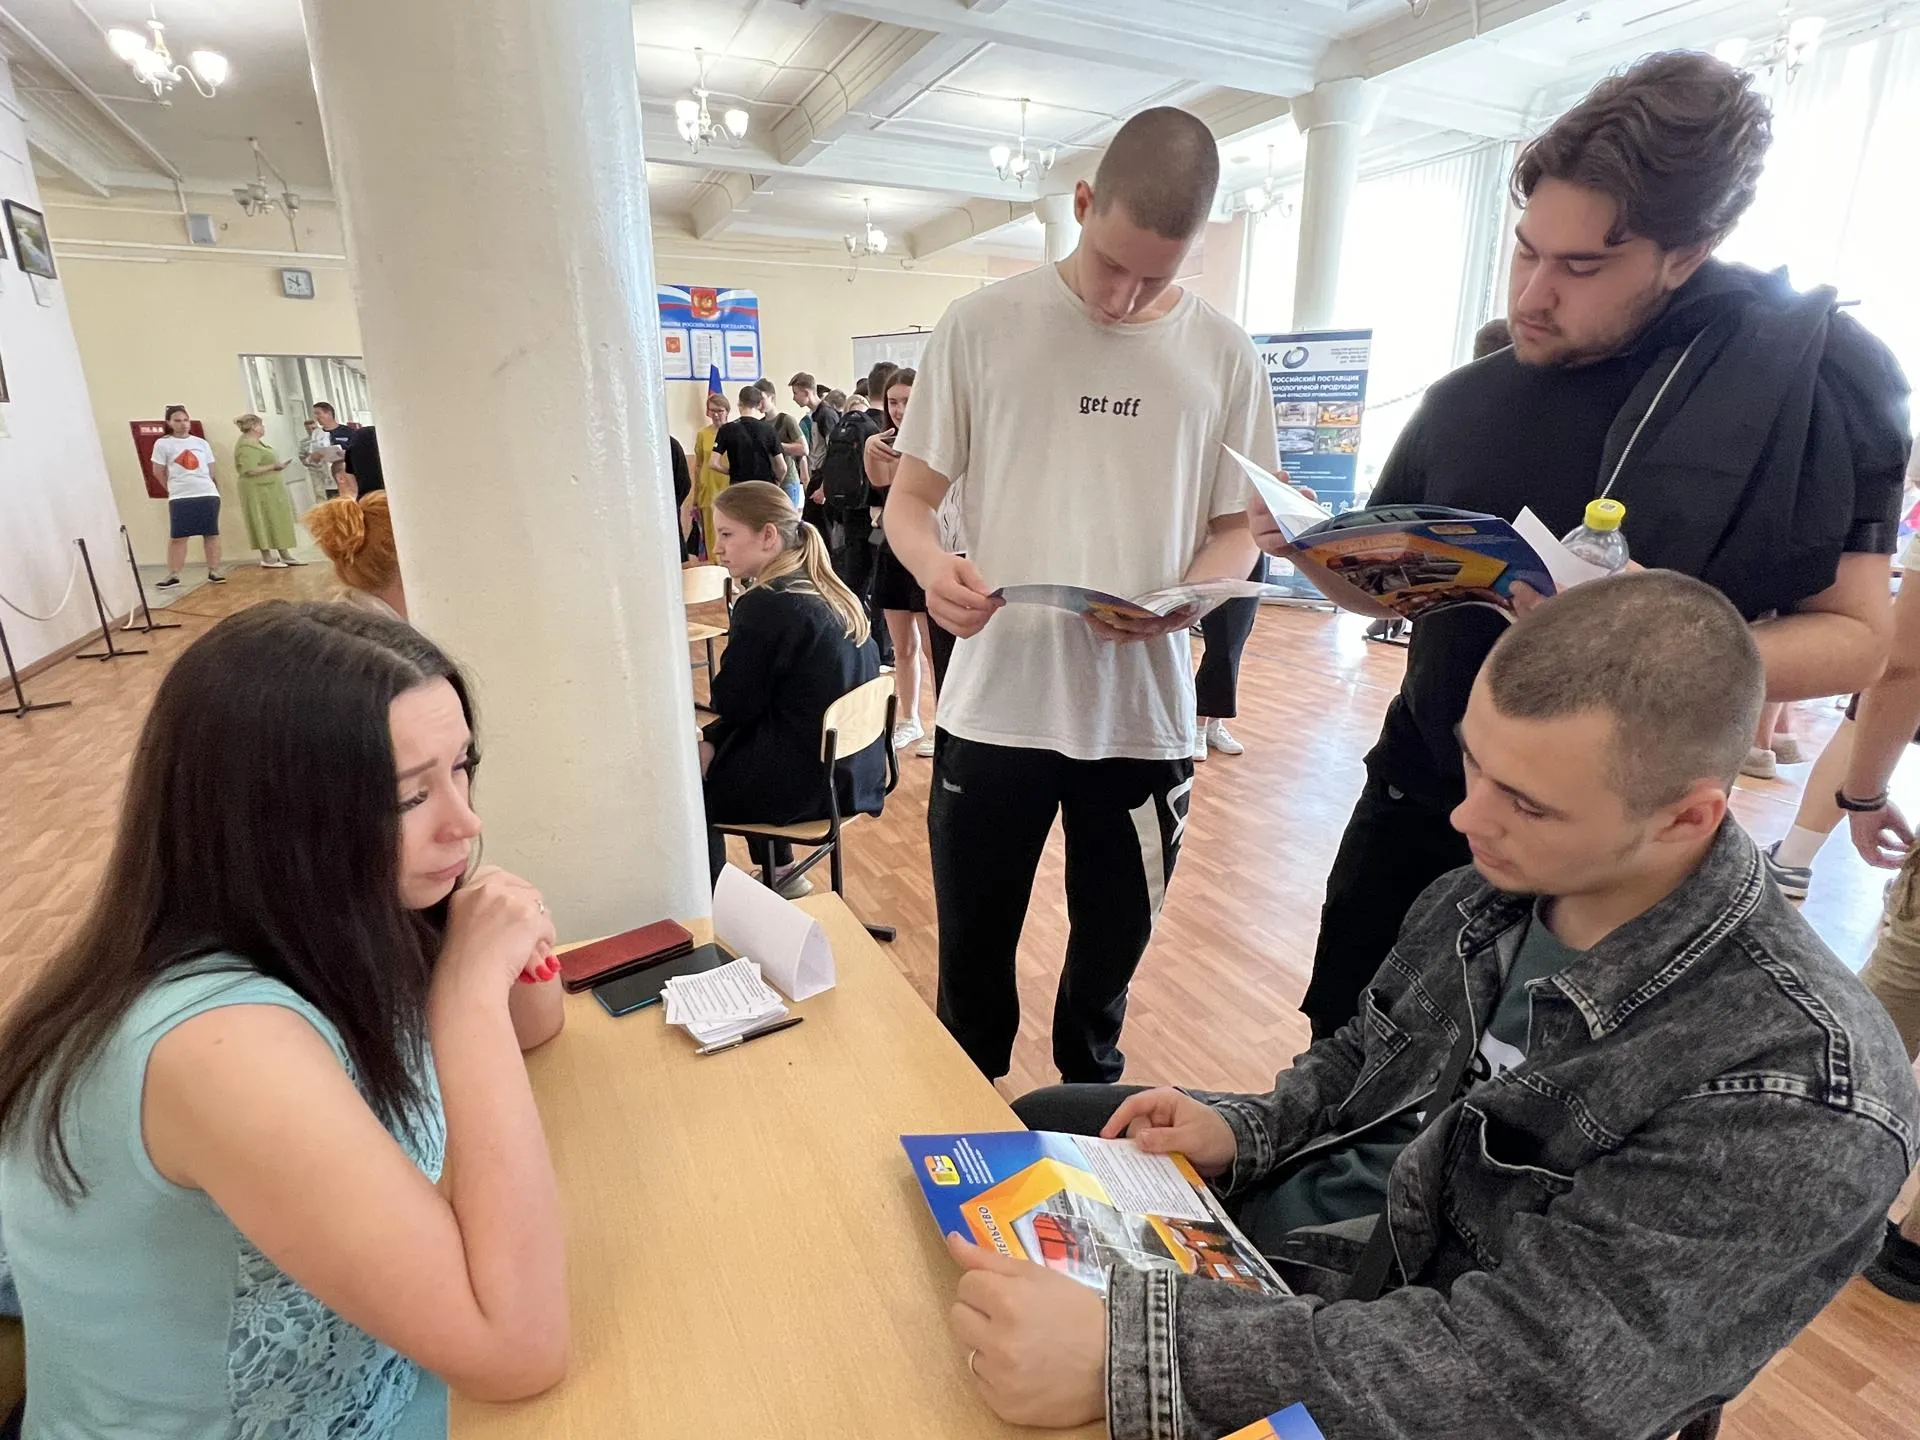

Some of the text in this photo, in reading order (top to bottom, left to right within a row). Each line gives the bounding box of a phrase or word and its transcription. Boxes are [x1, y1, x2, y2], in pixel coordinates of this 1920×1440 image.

[1271, 375, 1316, 383] РОССИЙСКИЙ
[1079, 395, 1141, 417] get off
[978, 1206, 1010, 1257] ТЕЛЬСТВО
